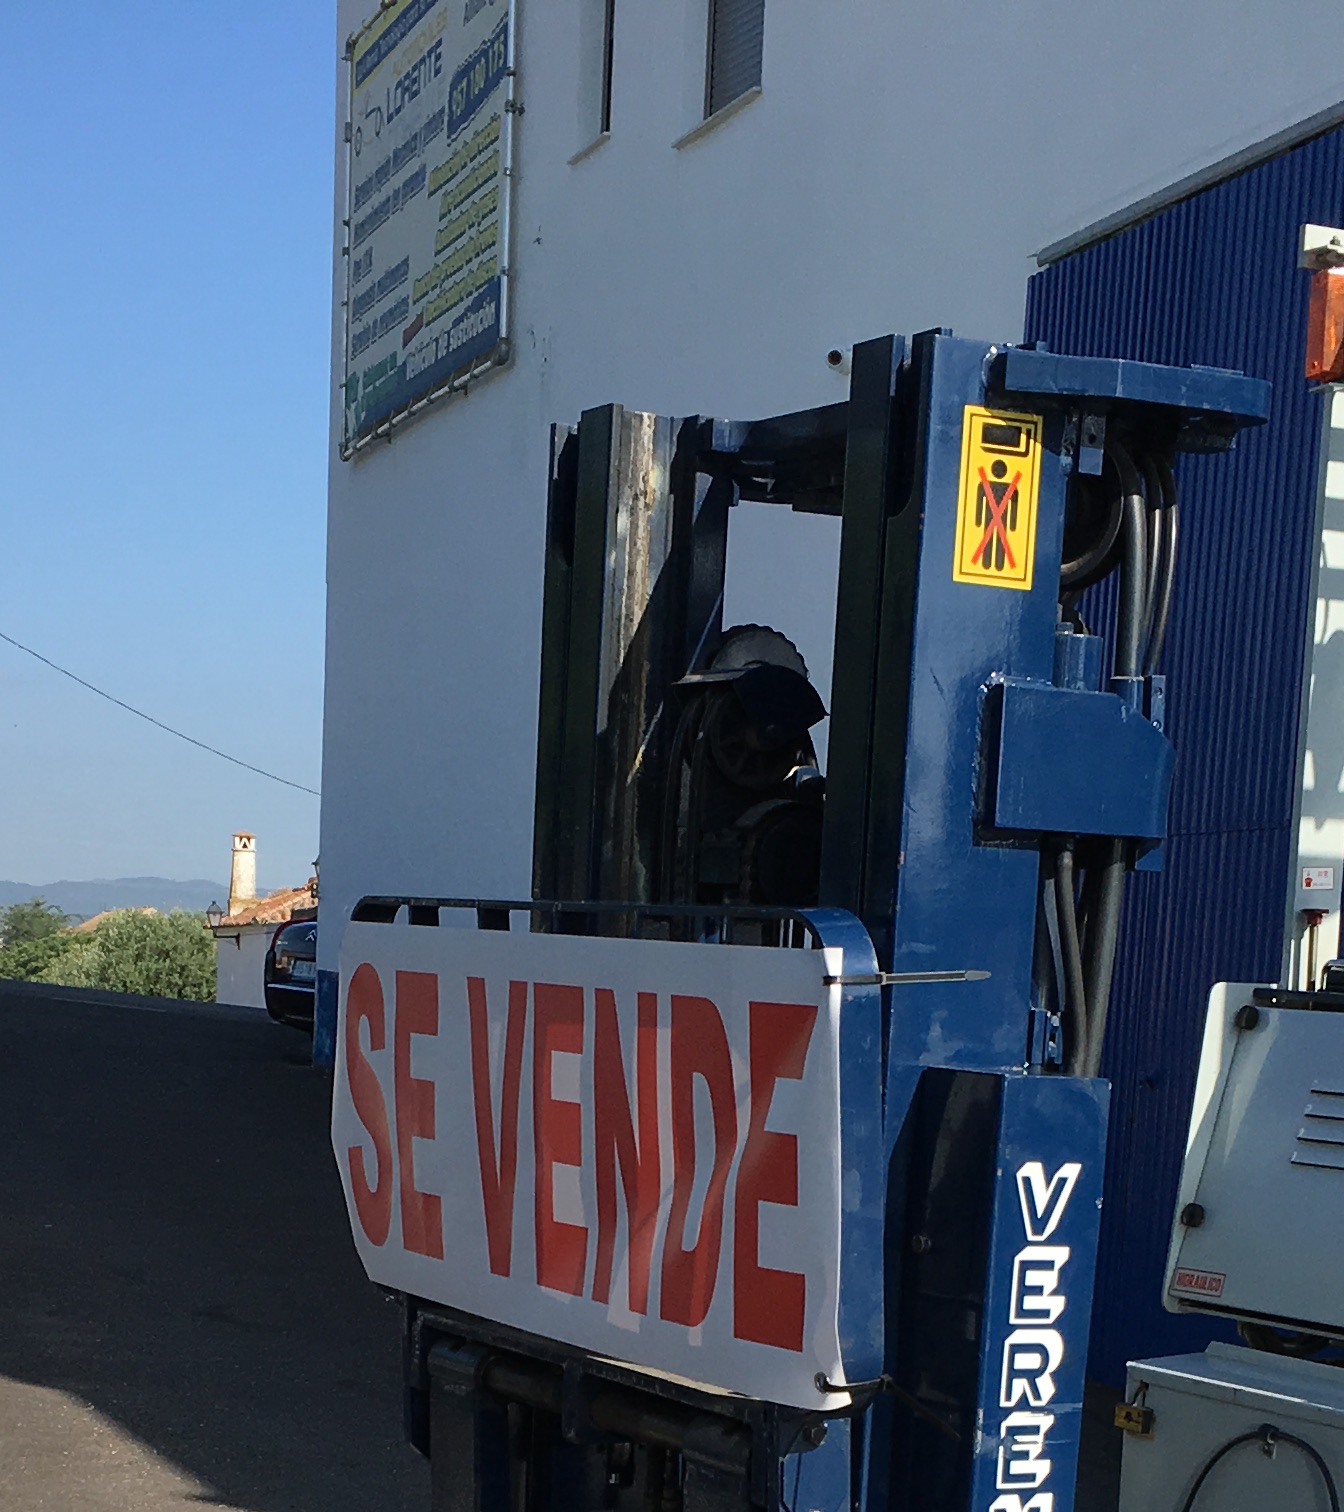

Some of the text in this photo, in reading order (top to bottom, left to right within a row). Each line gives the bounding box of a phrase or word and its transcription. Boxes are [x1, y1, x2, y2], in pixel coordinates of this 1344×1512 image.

[386, 37, 443, 125] LORENTE
[345, 962, 820, 1353] SE VENDE
